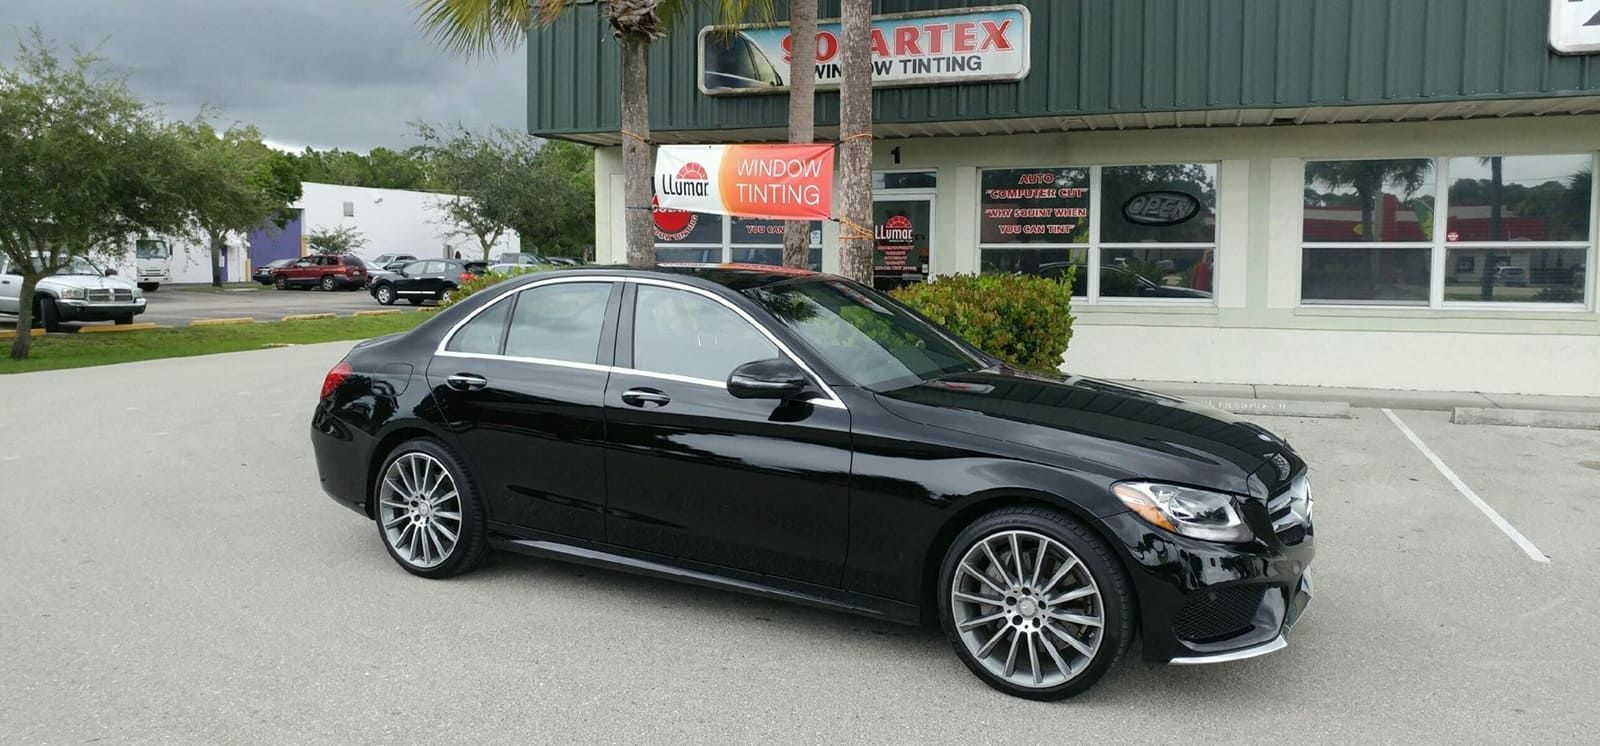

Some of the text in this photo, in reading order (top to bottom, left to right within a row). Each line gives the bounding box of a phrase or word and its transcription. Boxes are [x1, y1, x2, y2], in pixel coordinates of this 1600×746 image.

[781, 19, 1014, 64] OARTEX
[899, 55, 982, 75] TINTING
[891, 146, 901, 164] 1
[736, 159, 822, 178] WINDOW
[662, 174, 709, 197] LLumar
[1018, 173, 1055, 184] AUTO
[735, 183, 820, 206] TINTING
[1013, 208, 1053, 217] SQUINT
[1054, 208, 1087, 217] WHEN
[1128, 196, 1196, 220] OPEN
[745, 225, 785, 234] YOU CAN
[875, 224, 913, 240] LLumar
[998, 225, 1021, 234] YOU
[1023, 225, 1045, 234] CAN
